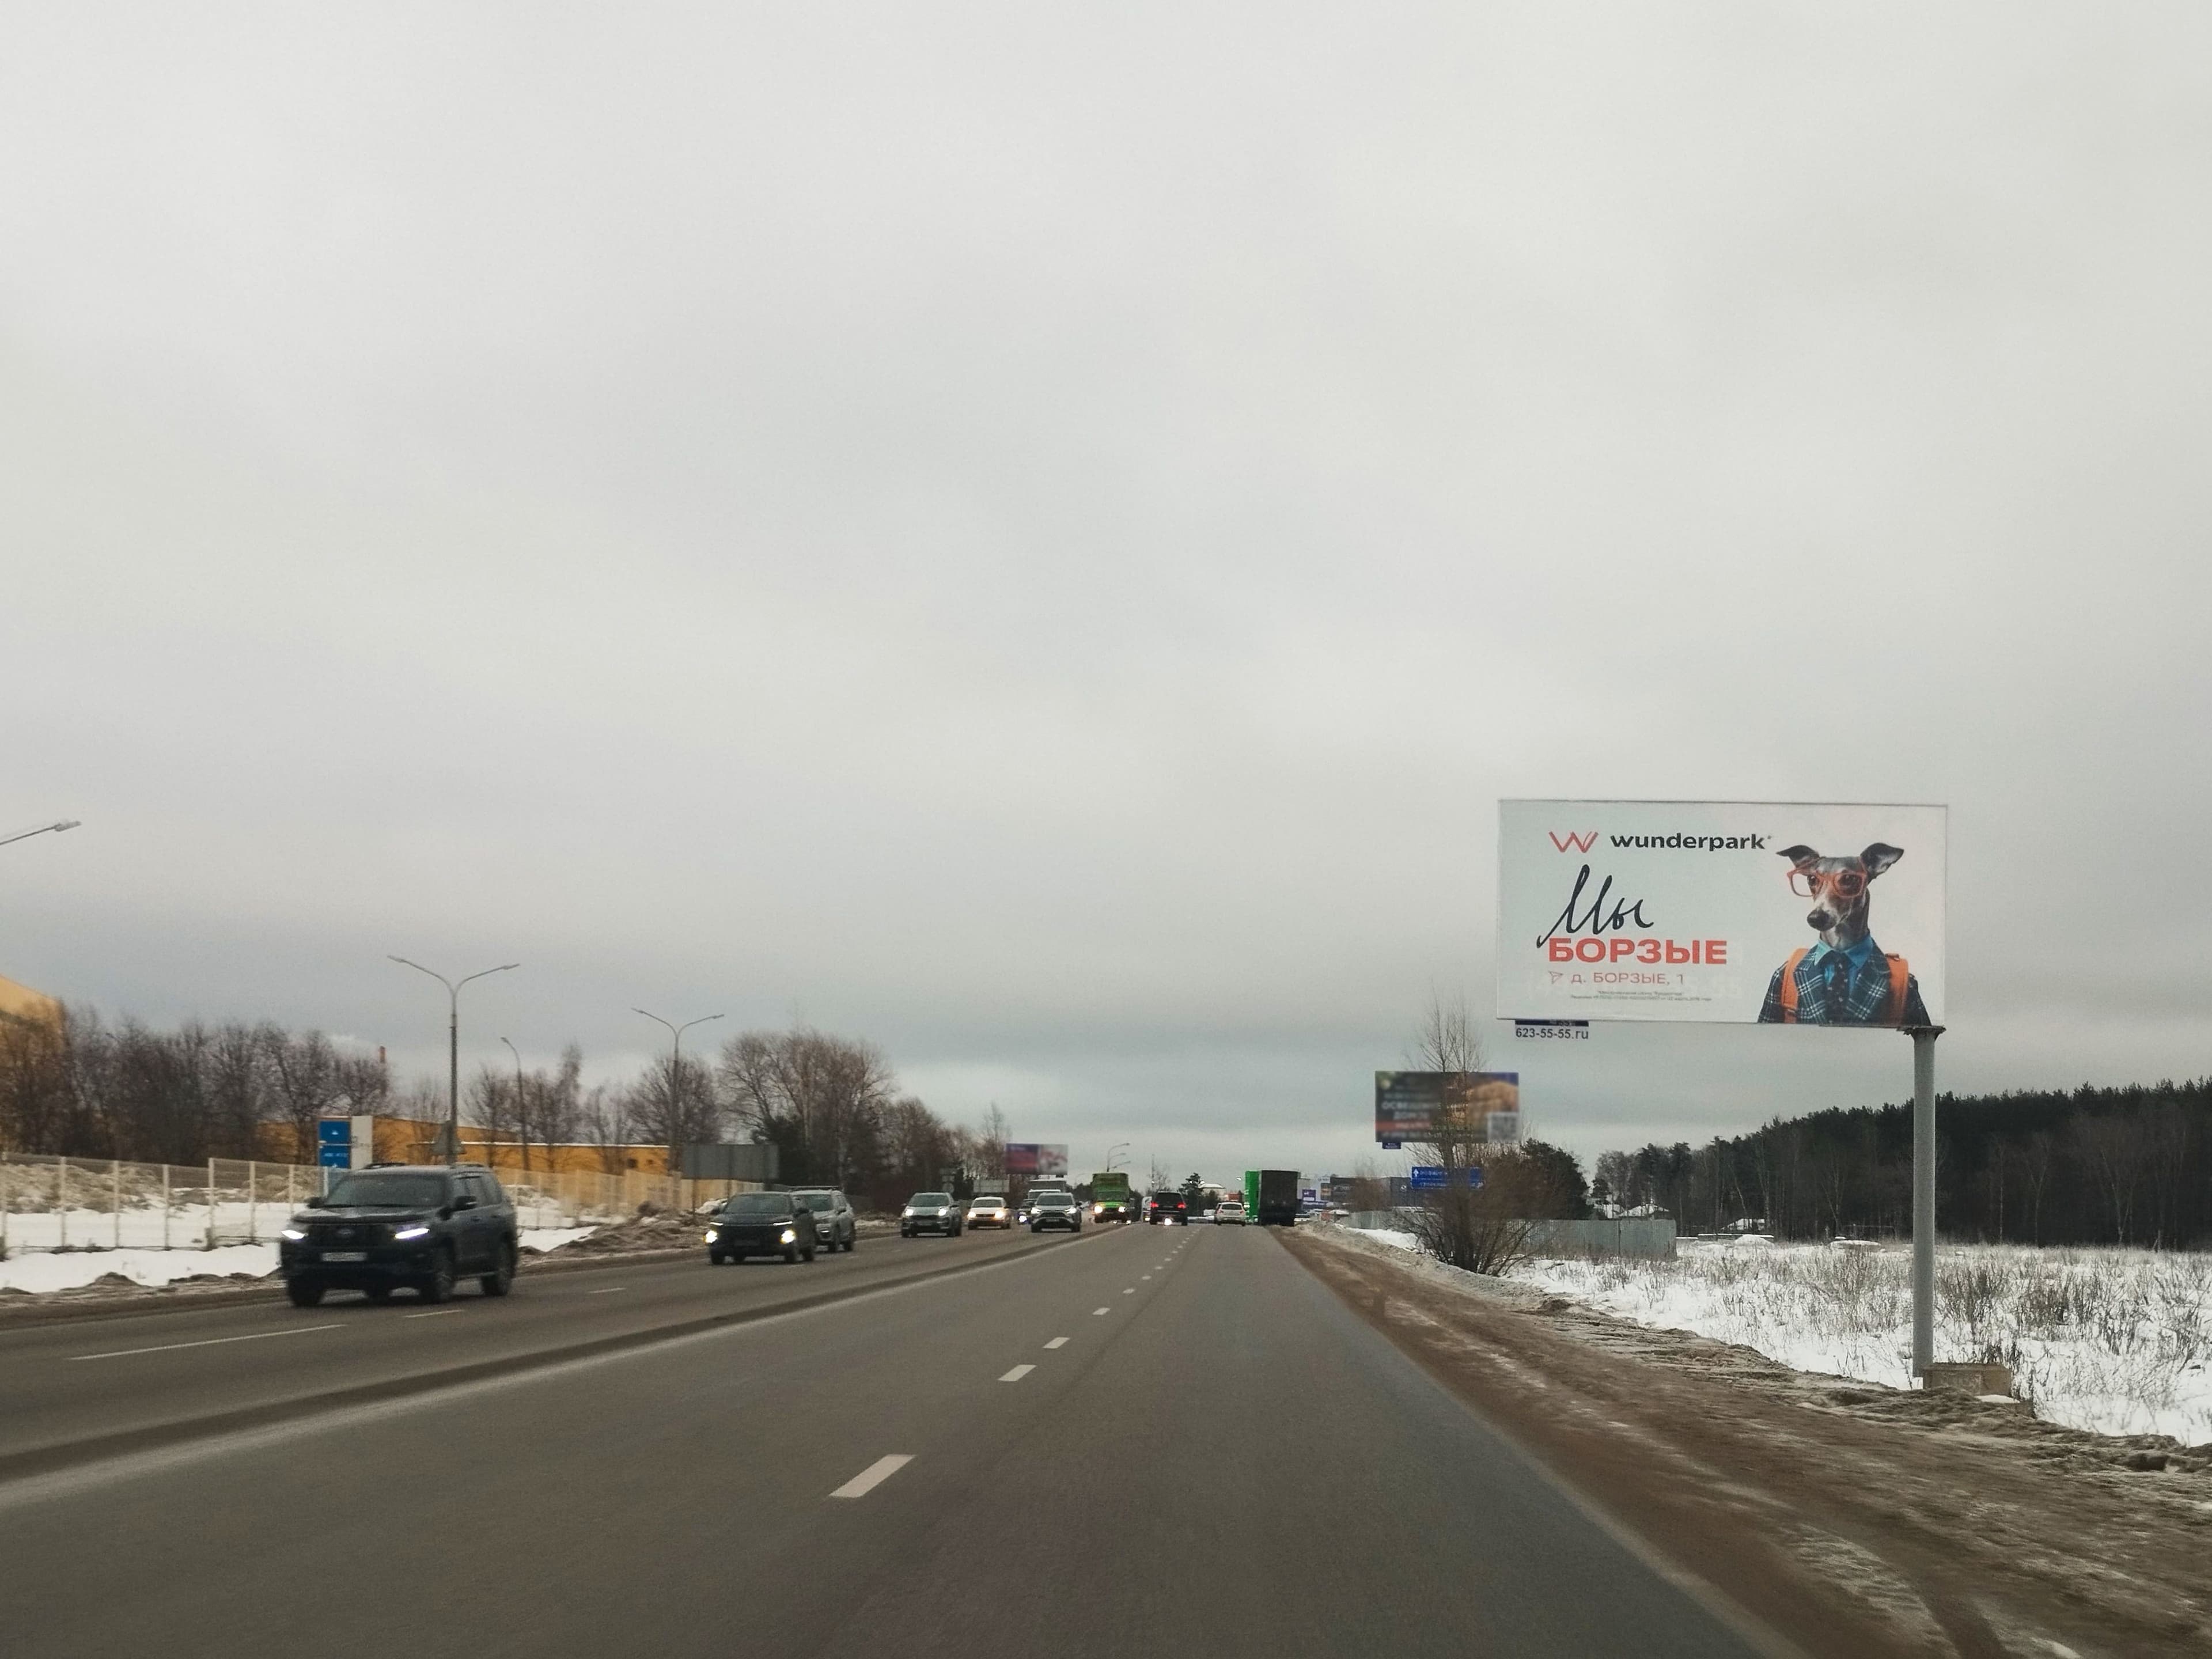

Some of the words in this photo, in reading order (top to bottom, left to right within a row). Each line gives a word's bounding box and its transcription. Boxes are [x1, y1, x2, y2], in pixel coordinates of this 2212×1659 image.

[1610, 832, 1766, 852] wunderpark
[1536, 863, 1654, 949] Мы
[1548, 937, 1728, 965] БОРЗЫЕ
[1593, 972, 1670, 986] БОРЗЫЕ,
[1676, 973, 1684, 984] 1
[1515, 1027, 1589, 1040] 623-55-55.ru
